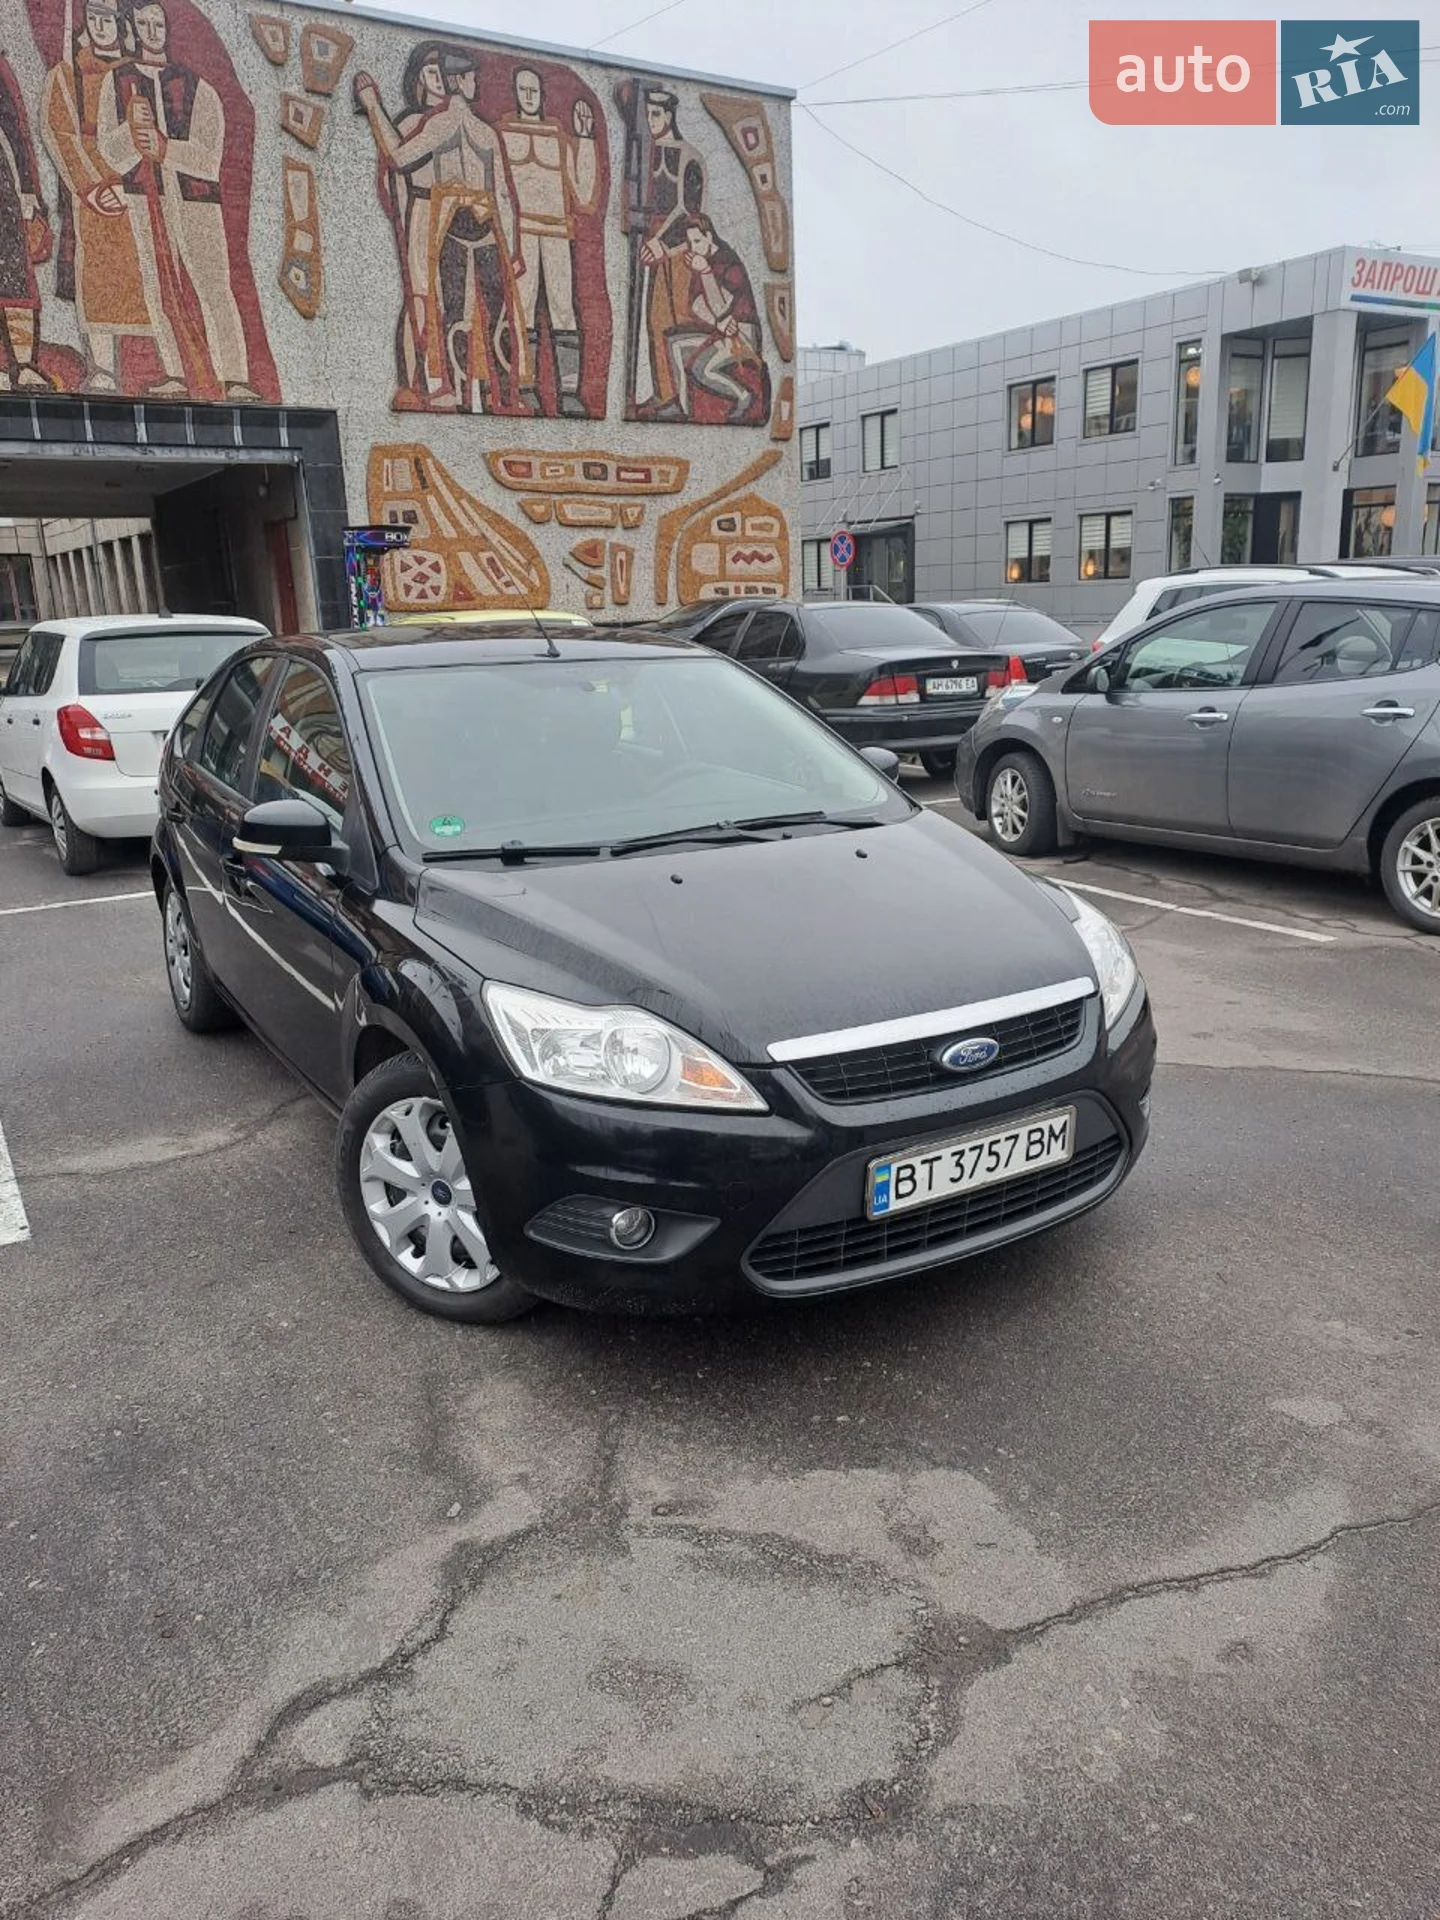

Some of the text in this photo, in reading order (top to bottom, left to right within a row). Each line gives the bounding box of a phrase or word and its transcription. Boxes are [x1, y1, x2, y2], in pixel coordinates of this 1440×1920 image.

[1351, 257, 1440, 297] ЗАПРОШ
[959, 1044, 988, 1064] Ford
[894, 1119, 1068, 1200] BT 3757 BM
[874, 1194, 888, 1205] UA
